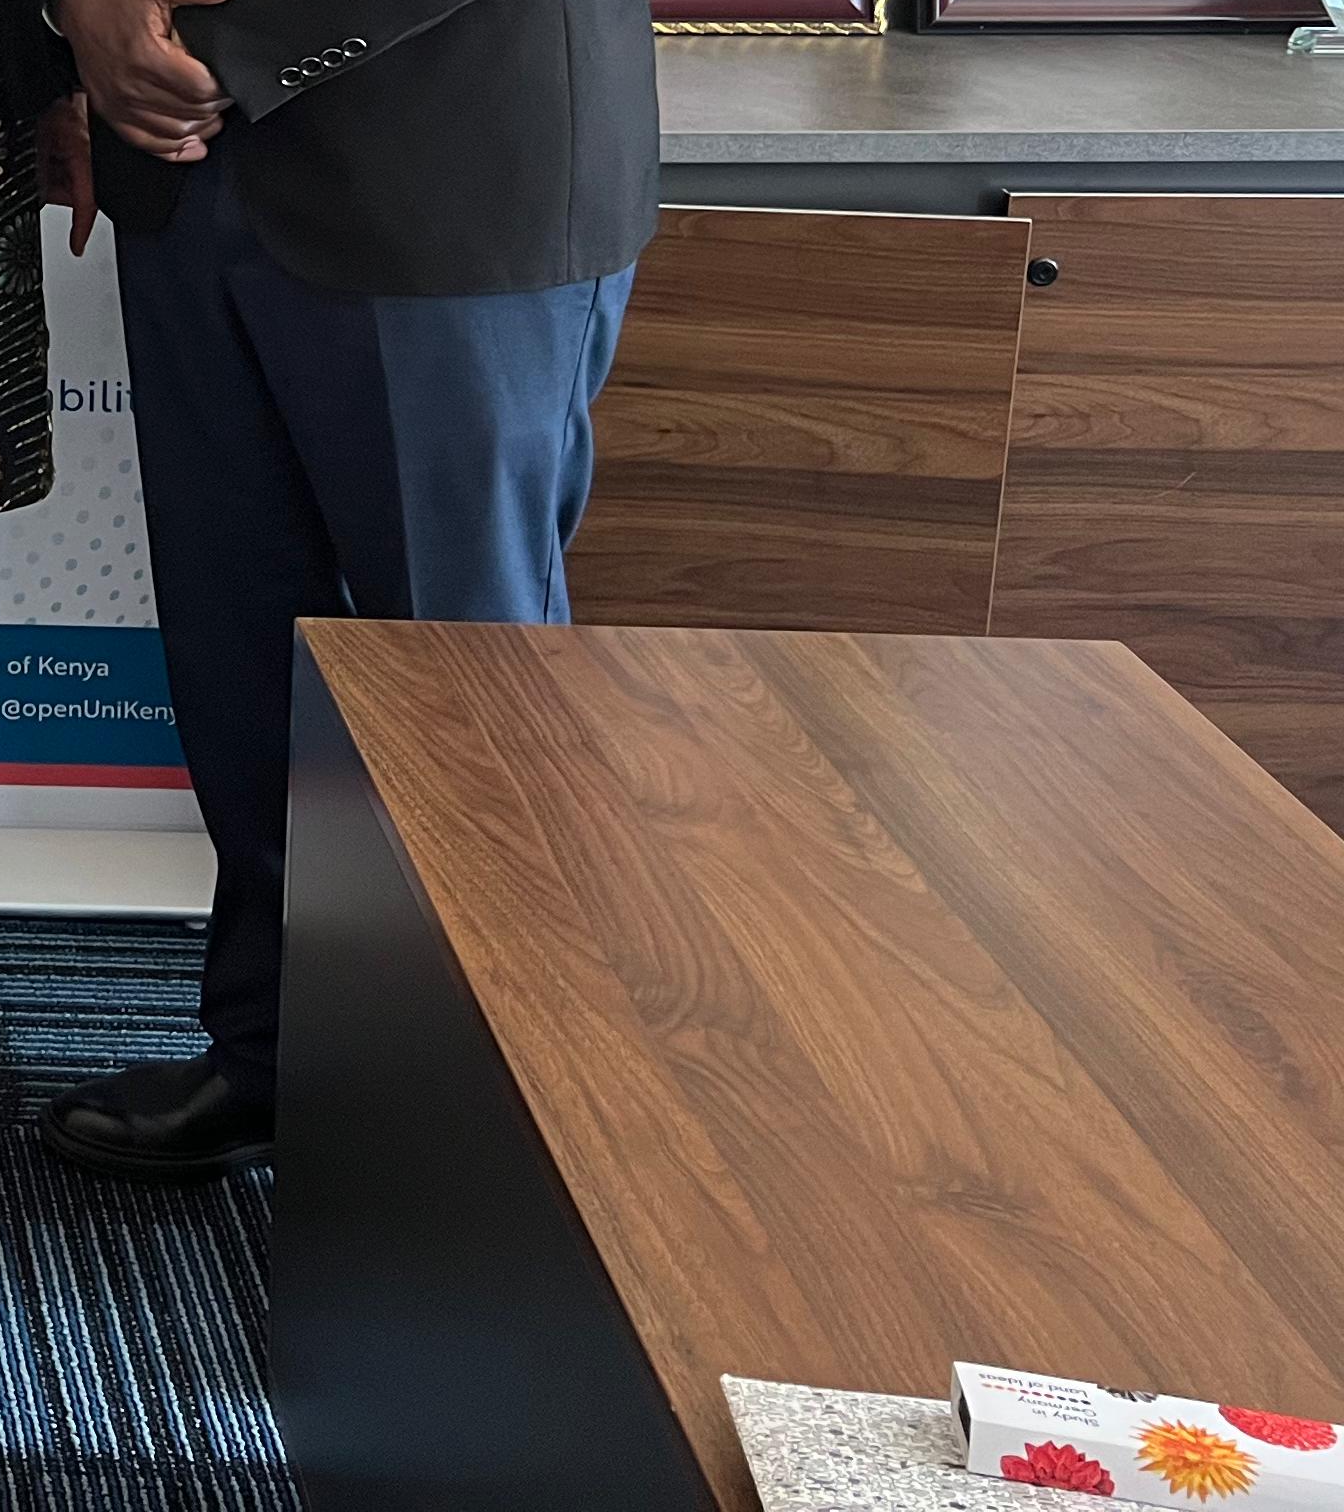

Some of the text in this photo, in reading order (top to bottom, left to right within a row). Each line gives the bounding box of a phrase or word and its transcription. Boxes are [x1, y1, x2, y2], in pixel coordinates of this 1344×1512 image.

[7, 655, 31, 675] of
[38, 656, 109, 681] Kenya
[978, 1372, 1088, 1398] Land of Ideas
[1017, 1396, 1097, 1417] Germany
[1032, 1408, 1100, 1427] Study in
